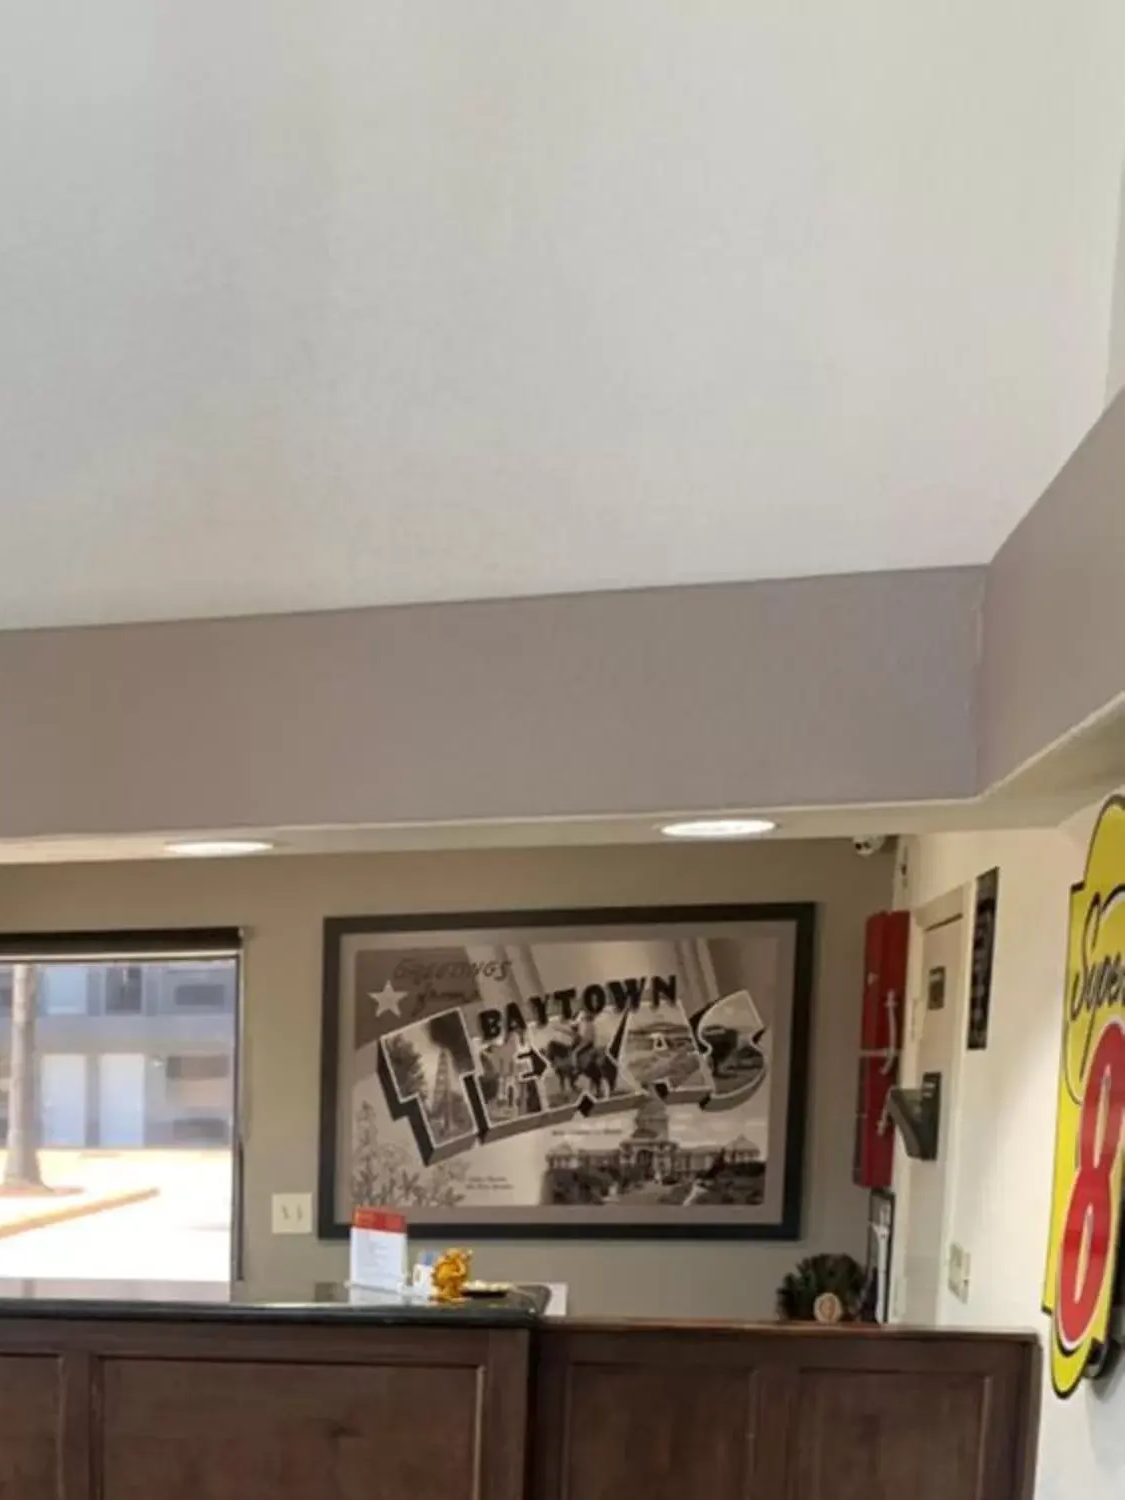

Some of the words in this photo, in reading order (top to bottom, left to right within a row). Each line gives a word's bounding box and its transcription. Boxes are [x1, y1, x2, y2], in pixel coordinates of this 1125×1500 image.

[376, 989, 769, 1167] TEXAS
[477, 974, 678, 1042] BAYTOWN
[1059, 1022, 1125, 1350] 8
